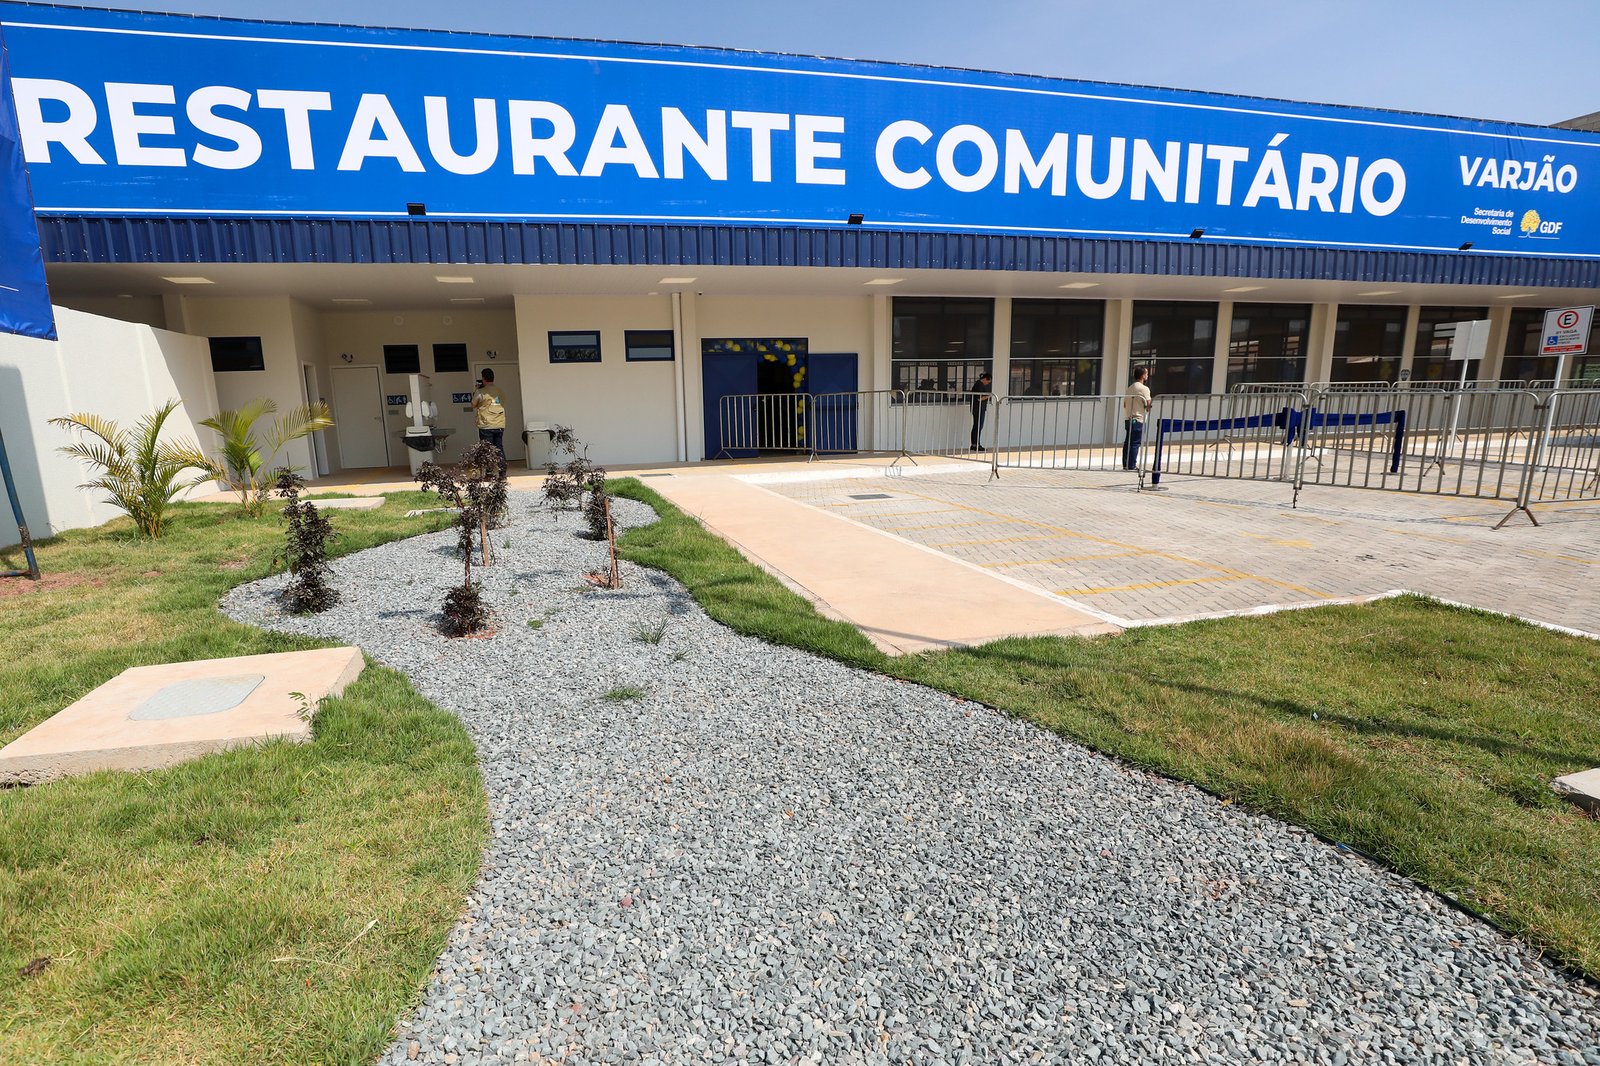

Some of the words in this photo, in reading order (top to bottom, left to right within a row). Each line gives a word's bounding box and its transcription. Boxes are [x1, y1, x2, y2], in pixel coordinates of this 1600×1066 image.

[10, 77, 846, 186] RESTAURANTE
[875, 119, 1407, 218] COMUNITÁRIO
[1459, 154, 1578, 194] VARJÃO
[1473, 207, 1505, 218] Secretaria
[1505, 209, 1514, 218] de
[1460, 215, 1513, 227] Desenvolvimento
[1491, 226, 1512, 236] Social
[1539, 221, 1563, 234] GDF
[1563, 314, 1572, 325] E
